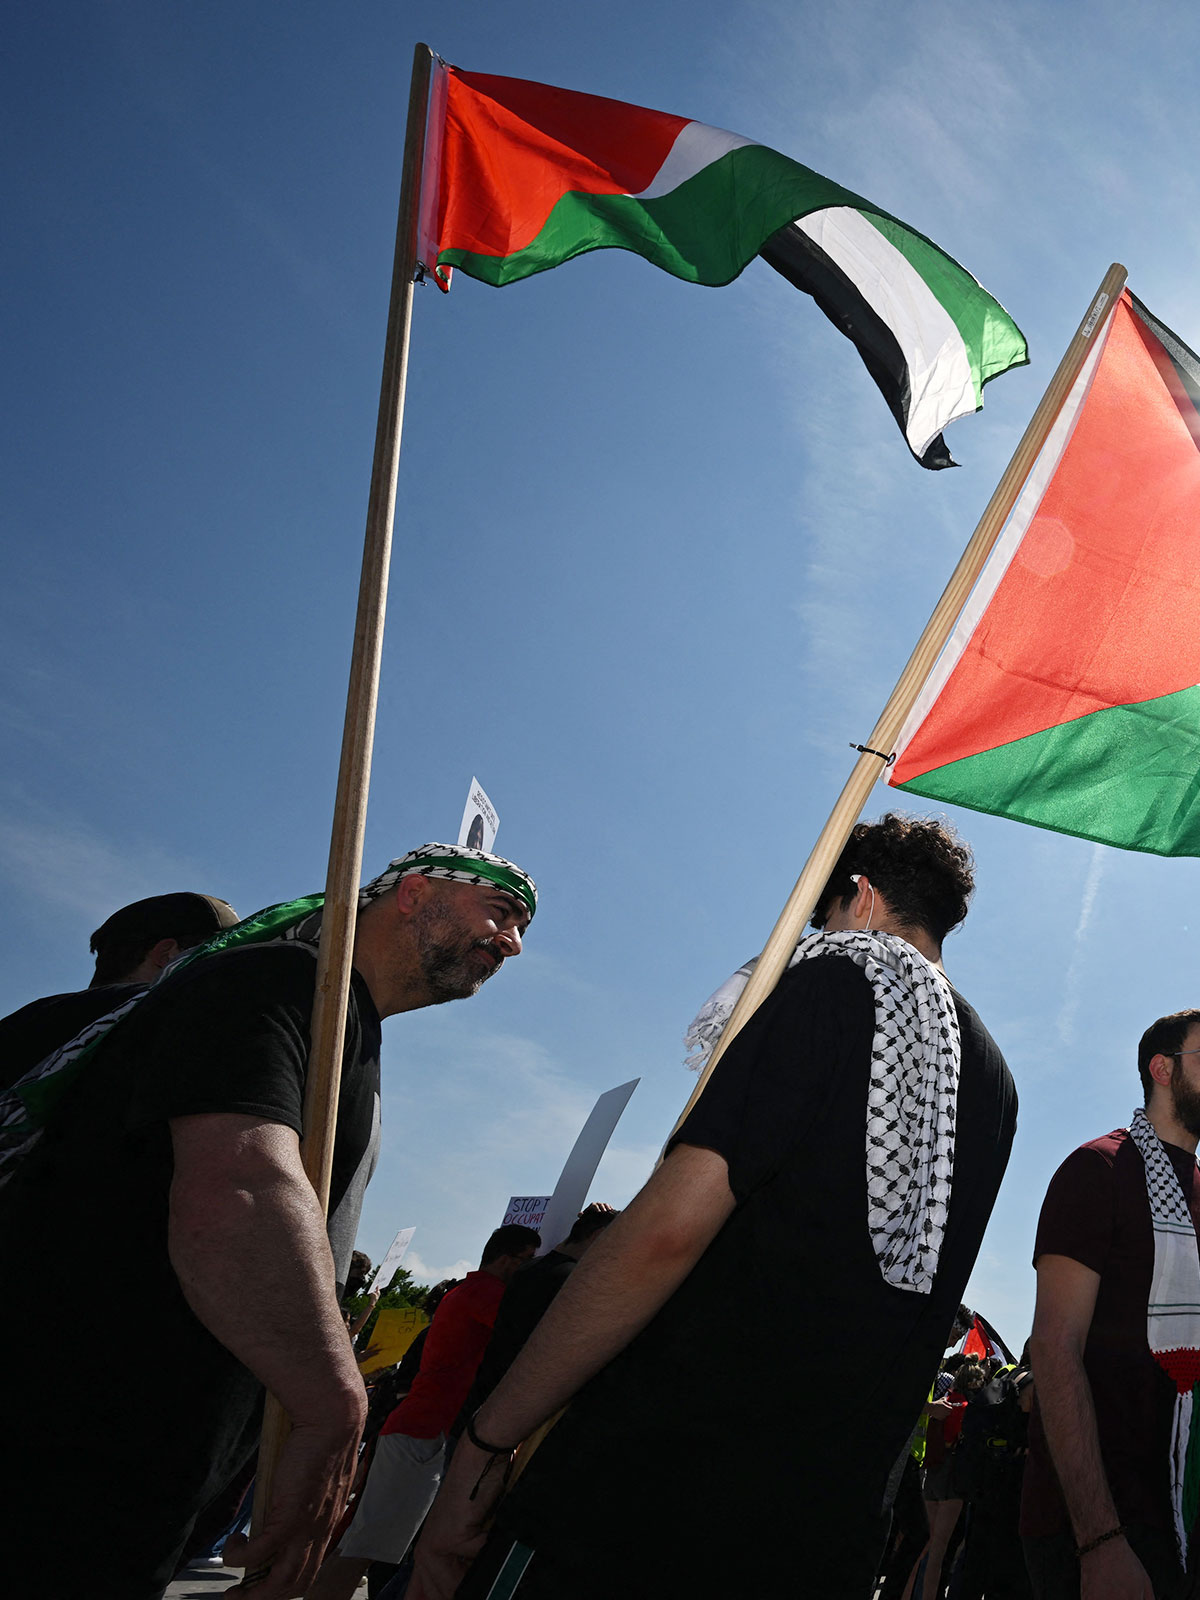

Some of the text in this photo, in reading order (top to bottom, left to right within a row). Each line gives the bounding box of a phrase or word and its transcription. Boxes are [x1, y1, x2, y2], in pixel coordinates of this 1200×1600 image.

[512, 1198, 551, 1212] STOP T
[503, 1212, 545, 1224] OCCUPAT
